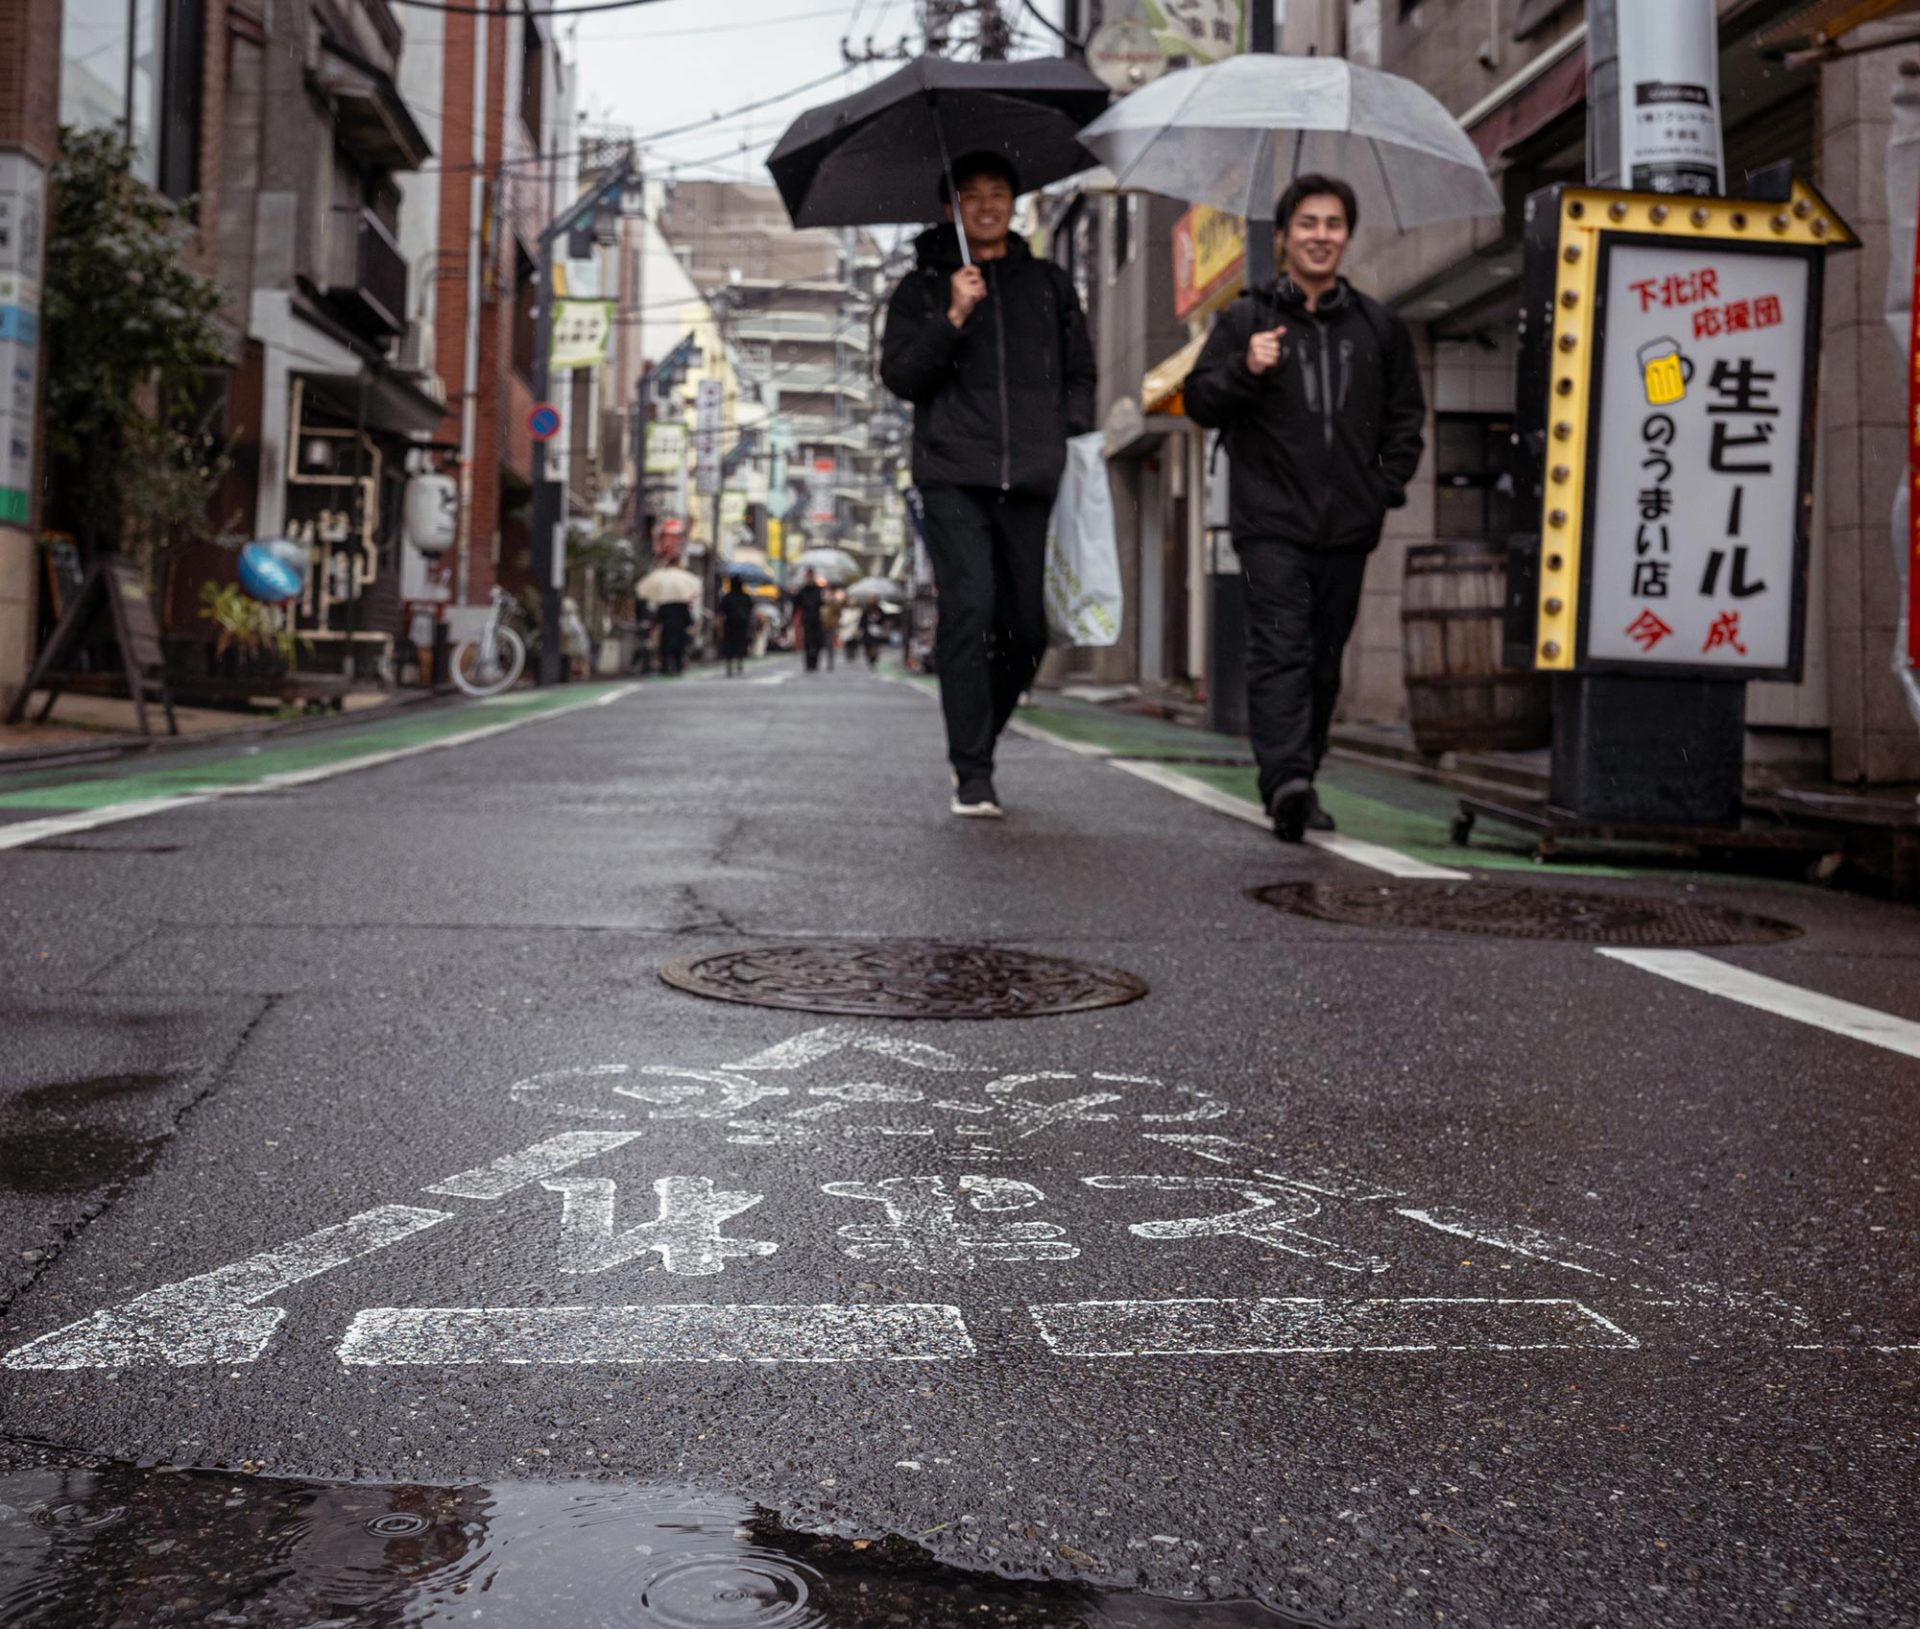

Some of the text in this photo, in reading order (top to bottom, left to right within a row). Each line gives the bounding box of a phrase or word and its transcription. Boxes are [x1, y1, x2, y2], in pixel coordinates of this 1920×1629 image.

[1629, 266, 1720, 312] 下北沢
[1691, 295, 1784, 341] 応援団
[1631, 412, 1677, 599] のうまい店
[1699, 358, 1781, 600] 生ビール
